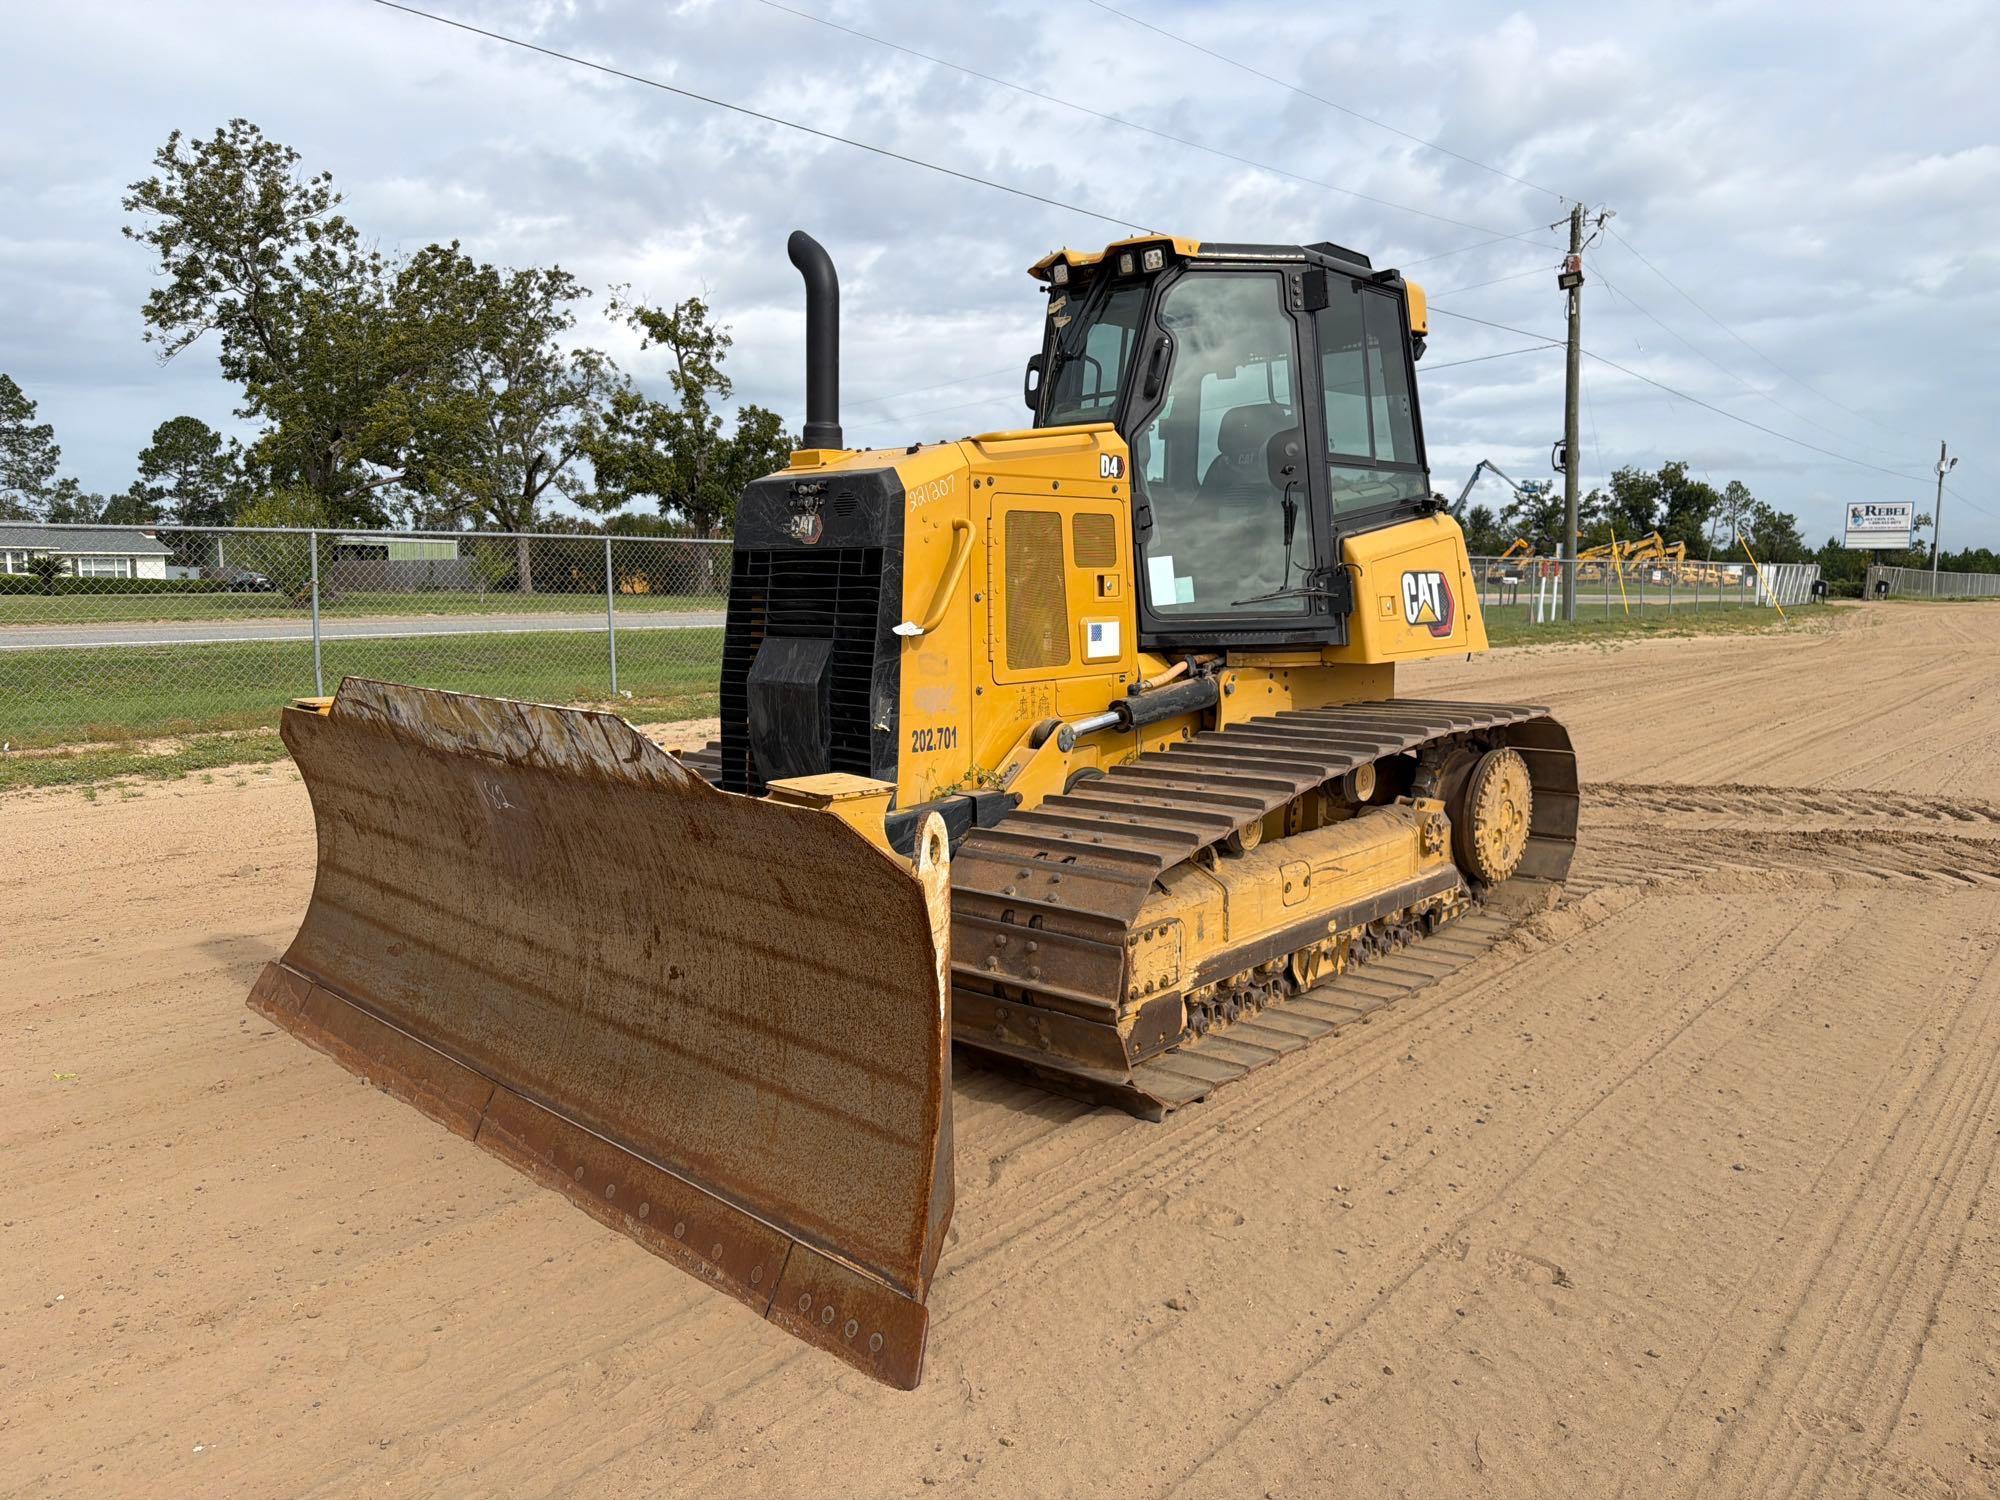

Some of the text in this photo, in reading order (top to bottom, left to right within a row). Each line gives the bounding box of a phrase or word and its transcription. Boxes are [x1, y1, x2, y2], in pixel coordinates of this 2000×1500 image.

[1101, 455, 1118, 477] D4
[909, 474, 955, 512] 221207
[1865, 505, 1909, 516] REBEL
[1402, 573, 1442, 624] CAT
[912, 726, 957, 752] 202.701
